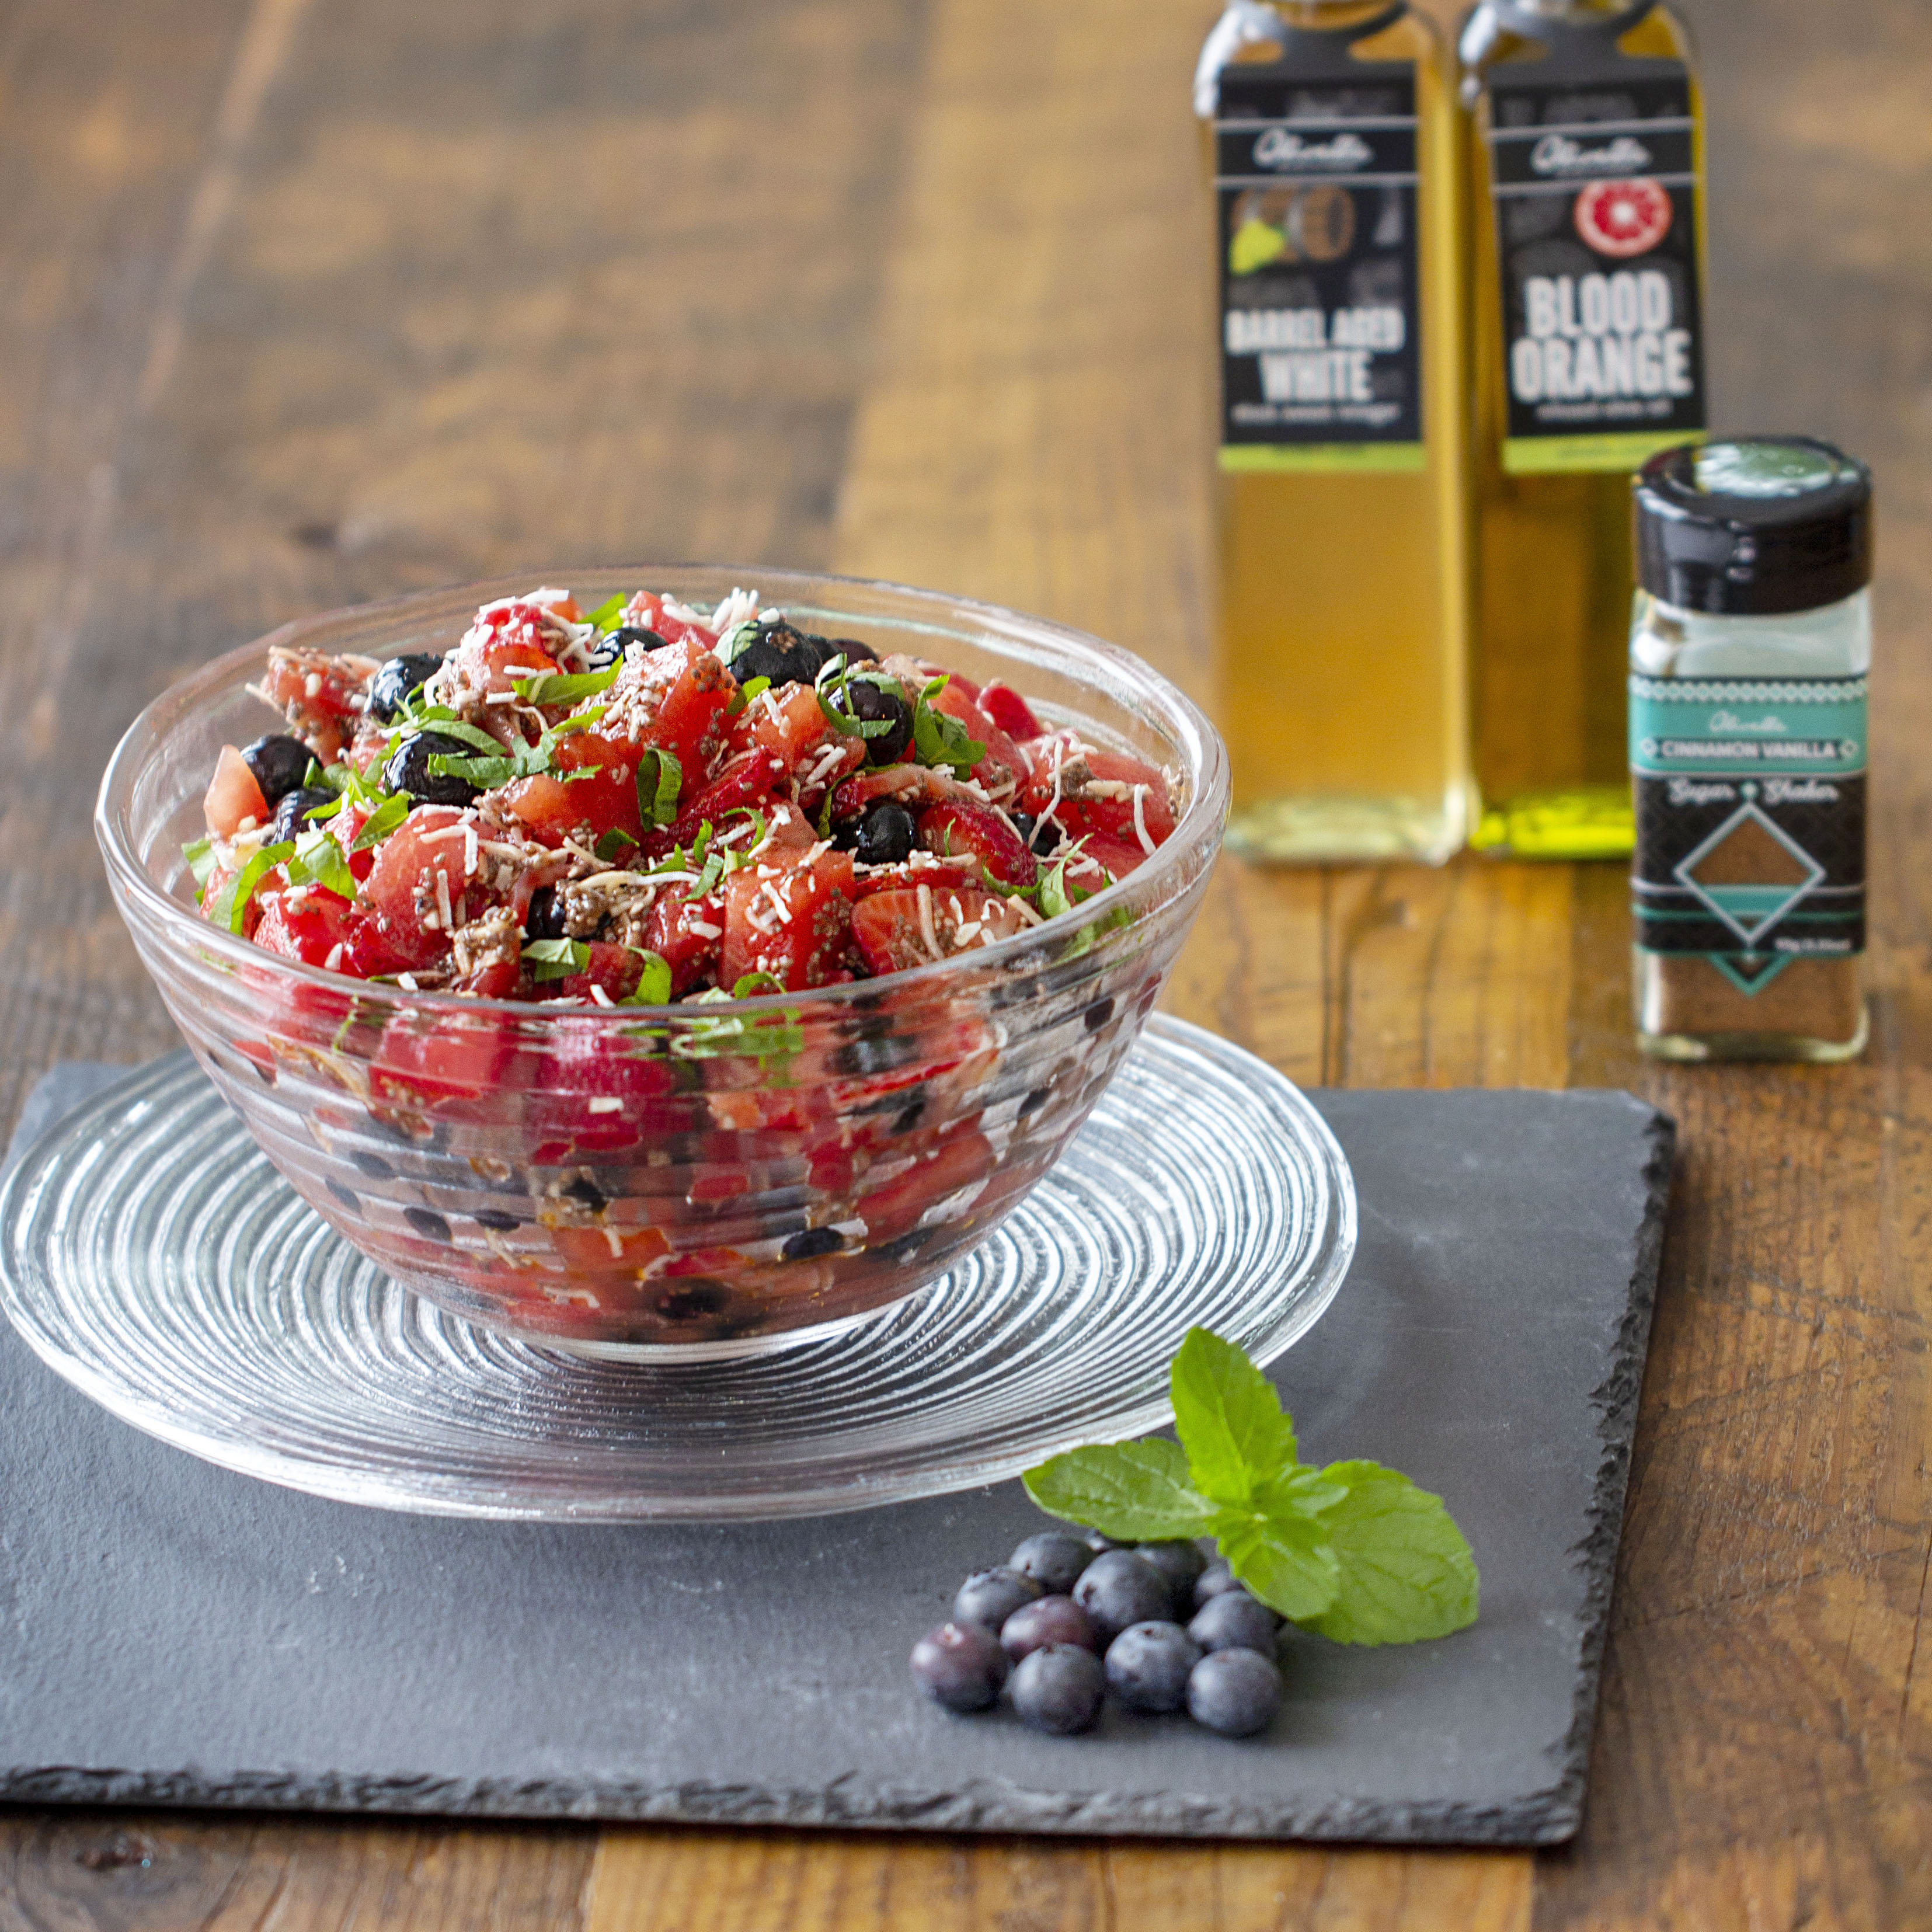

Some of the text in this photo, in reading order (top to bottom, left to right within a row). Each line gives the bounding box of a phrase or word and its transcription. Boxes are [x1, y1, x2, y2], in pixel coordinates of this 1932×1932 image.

[1525, 271, 1672, 337] BLOOD
[1259, 350, 1372, 402] WHITE
[1511, 328, 1693, 403] ORANGE
[1662, 740, 1836, 758] CINNAMON VANILLA
[1668, 778, 1840, 806] Sugar Shaker
